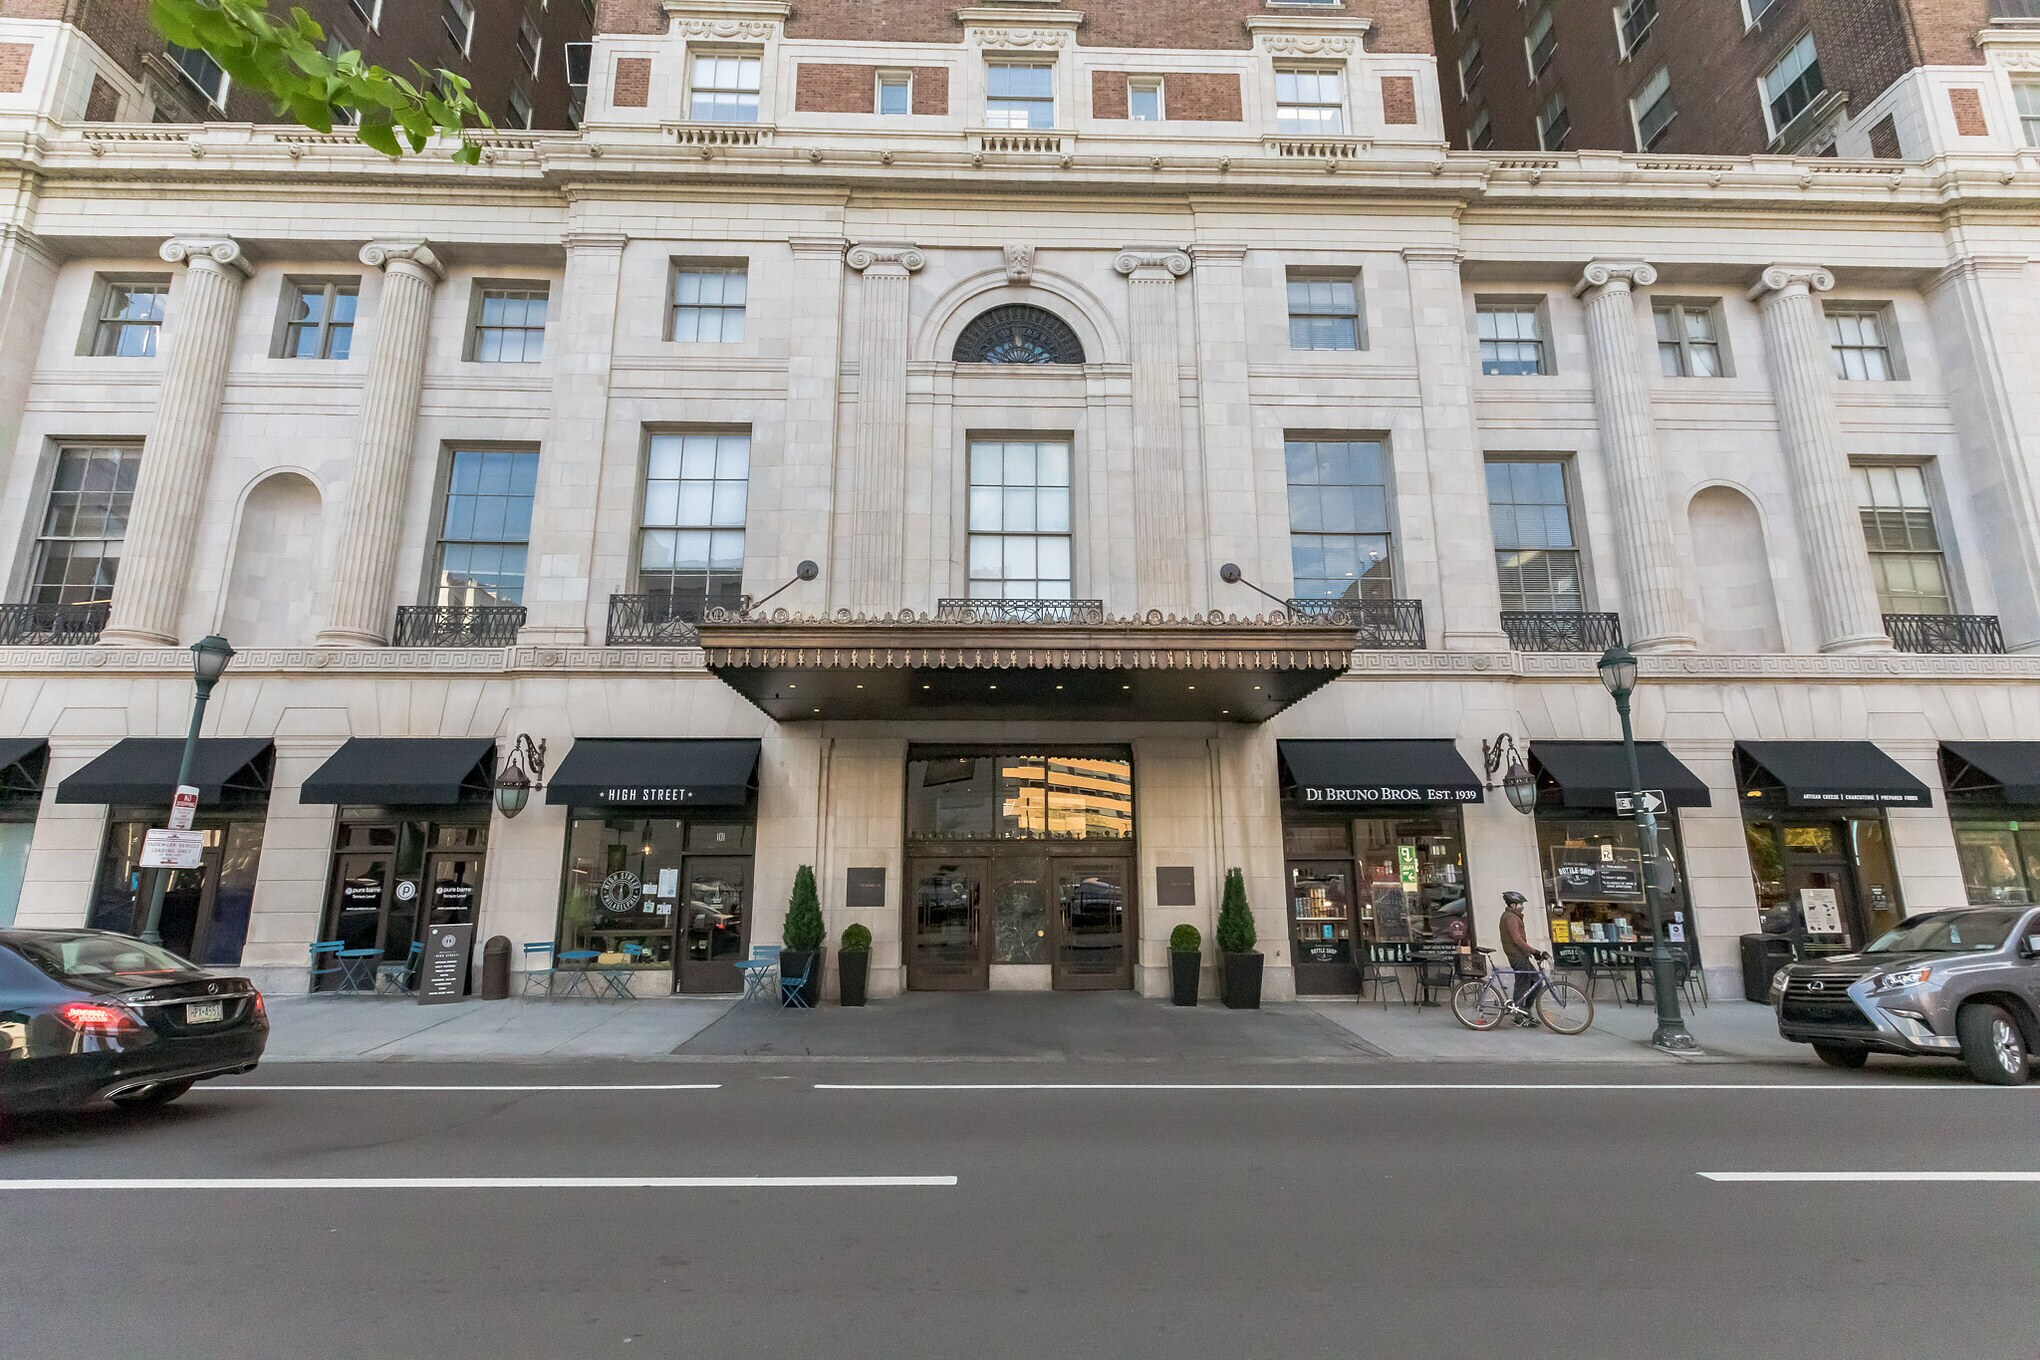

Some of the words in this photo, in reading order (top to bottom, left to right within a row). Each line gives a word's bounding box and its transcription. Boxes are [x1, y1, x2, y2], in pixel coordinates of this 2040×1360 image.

[608, 789, 637, 801] HIGH
[643, 789, 685, 801] STREET
[1306, 788, 1323, 800] DI
[1325, 788, 1378, 800] BRUNO
[1381, 787, 1422, 800] BROS.
[1427, 789, 1453, 800] EST.
[1455, 790, 1477, 800] 1939
[1558, 867, 1579, 875] BOTTLE
[1580, 867, 1596, 876] SHOP
